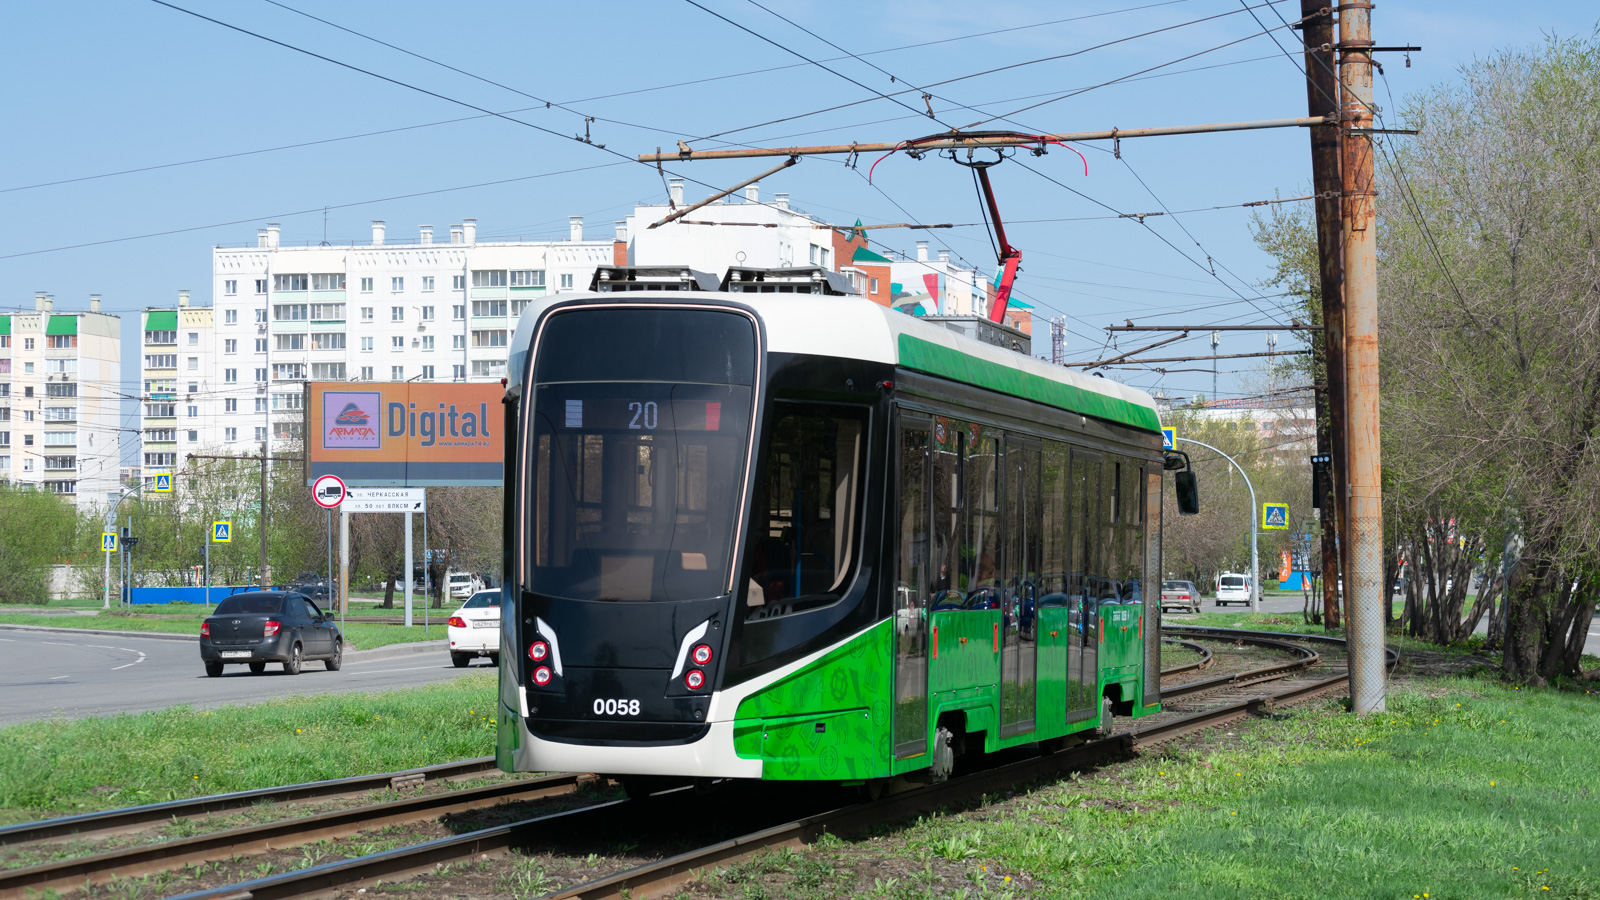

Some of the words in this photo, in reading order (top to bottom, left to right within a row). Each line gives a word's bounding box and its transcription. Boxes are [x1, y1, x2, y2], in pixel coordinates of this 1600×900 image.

[388, 402, 490, 447] Digital
[628, 401, 658, 429] 20
[328, 427, 375, 440] ARMADA
[593, 698, 641, 716] 0058
